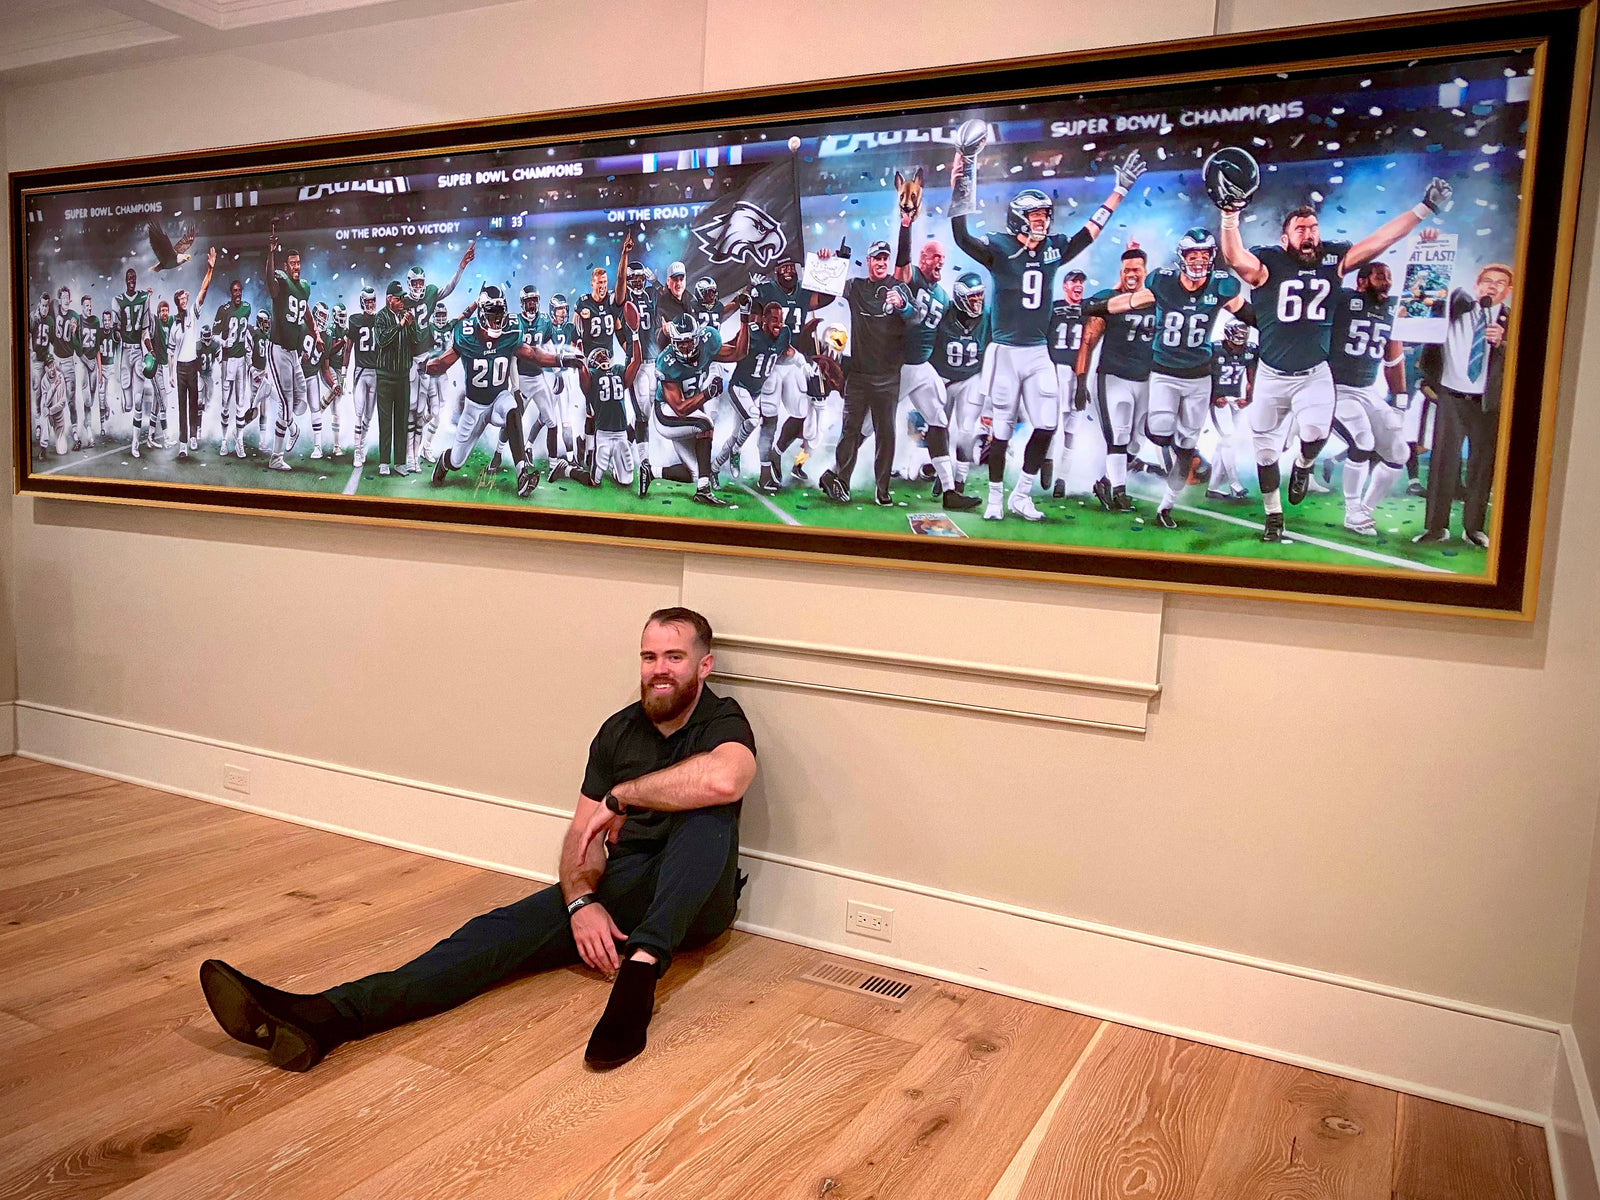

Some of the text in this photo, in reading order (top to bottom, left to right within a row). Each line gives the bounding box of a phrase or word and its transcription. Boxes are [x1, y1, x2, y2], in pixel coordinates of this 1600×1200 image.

[1051, 101, 1304, 137] SUPER BOWL CHAMPIONS
[437, 163, 583, 188] SUPER BOWL CHAMPIONS
[64, 202, 162, 220] SUPER BOWL CHAMPIONS
[491, 217, 502, 228] 41
[511, 216, 522, 228] 33
[607, 210, 625, 222] ON
[627, 208, 651, 221] THE
[653, 206, 689, 220] ROAD
[335, 222, 460, 240] ON THE ROAD TO VICTORY
[1408, 250, 1455, 261] AT LAST!
[1022, 270, 1043, 310] 9
[1276, 278, 1331, 322] 62
[124, 304, 143, 332] 17
[285, 294, 307, 325] 92
[639, 304, 651, 330] 5
[916, 288, 944, 329] 65
[36, 323, 50, 346] 15
[55, 315, 72, 342] 60
[82, 327, 97, 348] 25
[228, 316, 248, 348] 82
[591, 314, 614, 338] 69
[1054, 322, 1083, 350] 11
[1125, 314, 1156, 342] 79
[1163, 311, 1209, 348] 86
[1344, 319, 1391, 359] 55
[750, 353, 778, 378] 10
[946, 341, 979, 367] 91
[472, 356, 509, 388] 20
[1219, 365, 1246, 385] 27
[598, 375, 624, 402] 36
